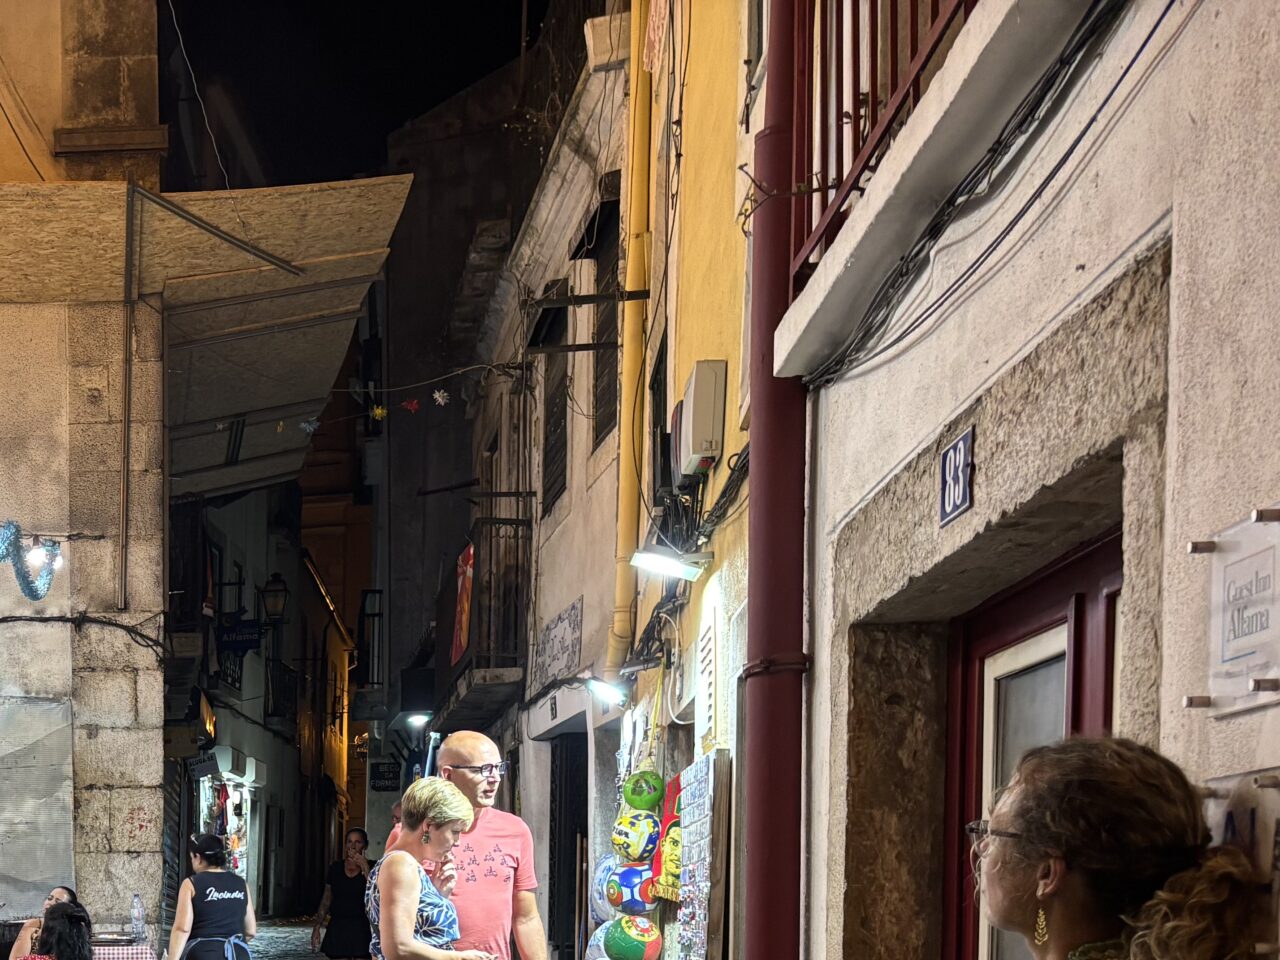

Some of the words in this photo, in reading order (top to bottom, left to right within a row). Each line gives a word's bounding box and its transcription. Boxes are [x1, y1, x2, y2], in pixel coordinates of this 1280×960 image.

[945, 440, 964, 513] 83
[1227, 578, 1253, 604] Guest
[1255, 569, 1271, 595] Inn
[1227, 606, 1270, 642] Alfama
